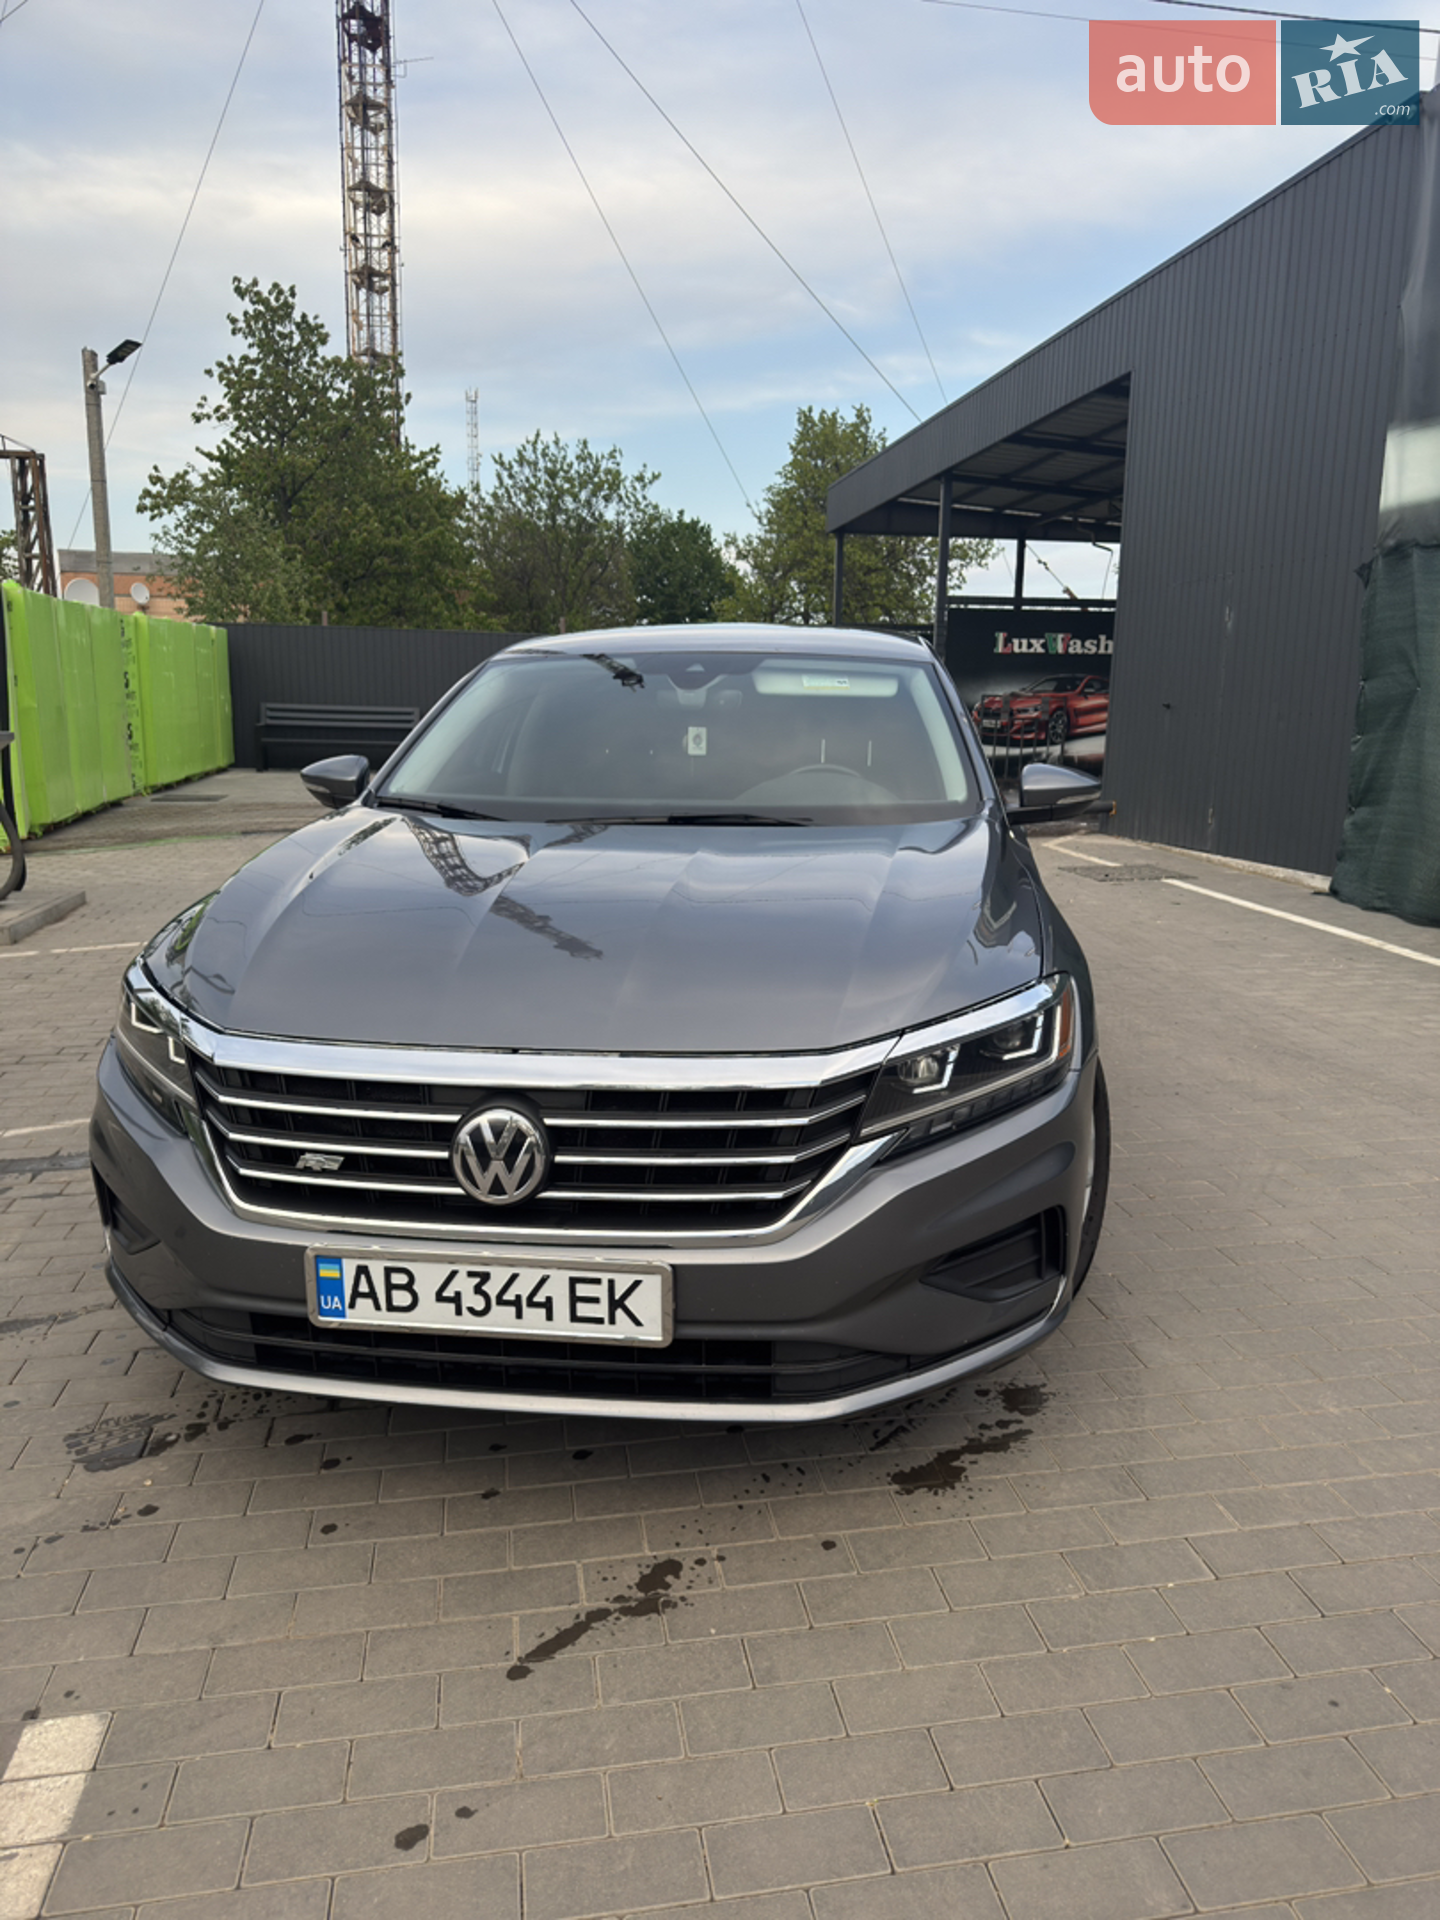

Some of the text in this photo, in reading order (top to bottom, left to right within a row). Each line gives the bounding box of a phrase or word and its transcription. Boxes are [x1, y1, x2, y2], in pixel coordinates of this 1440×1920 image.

[320, 1294, 342, 1312] UA
[348, 1265, 644, 1327] AB 4344 EK
